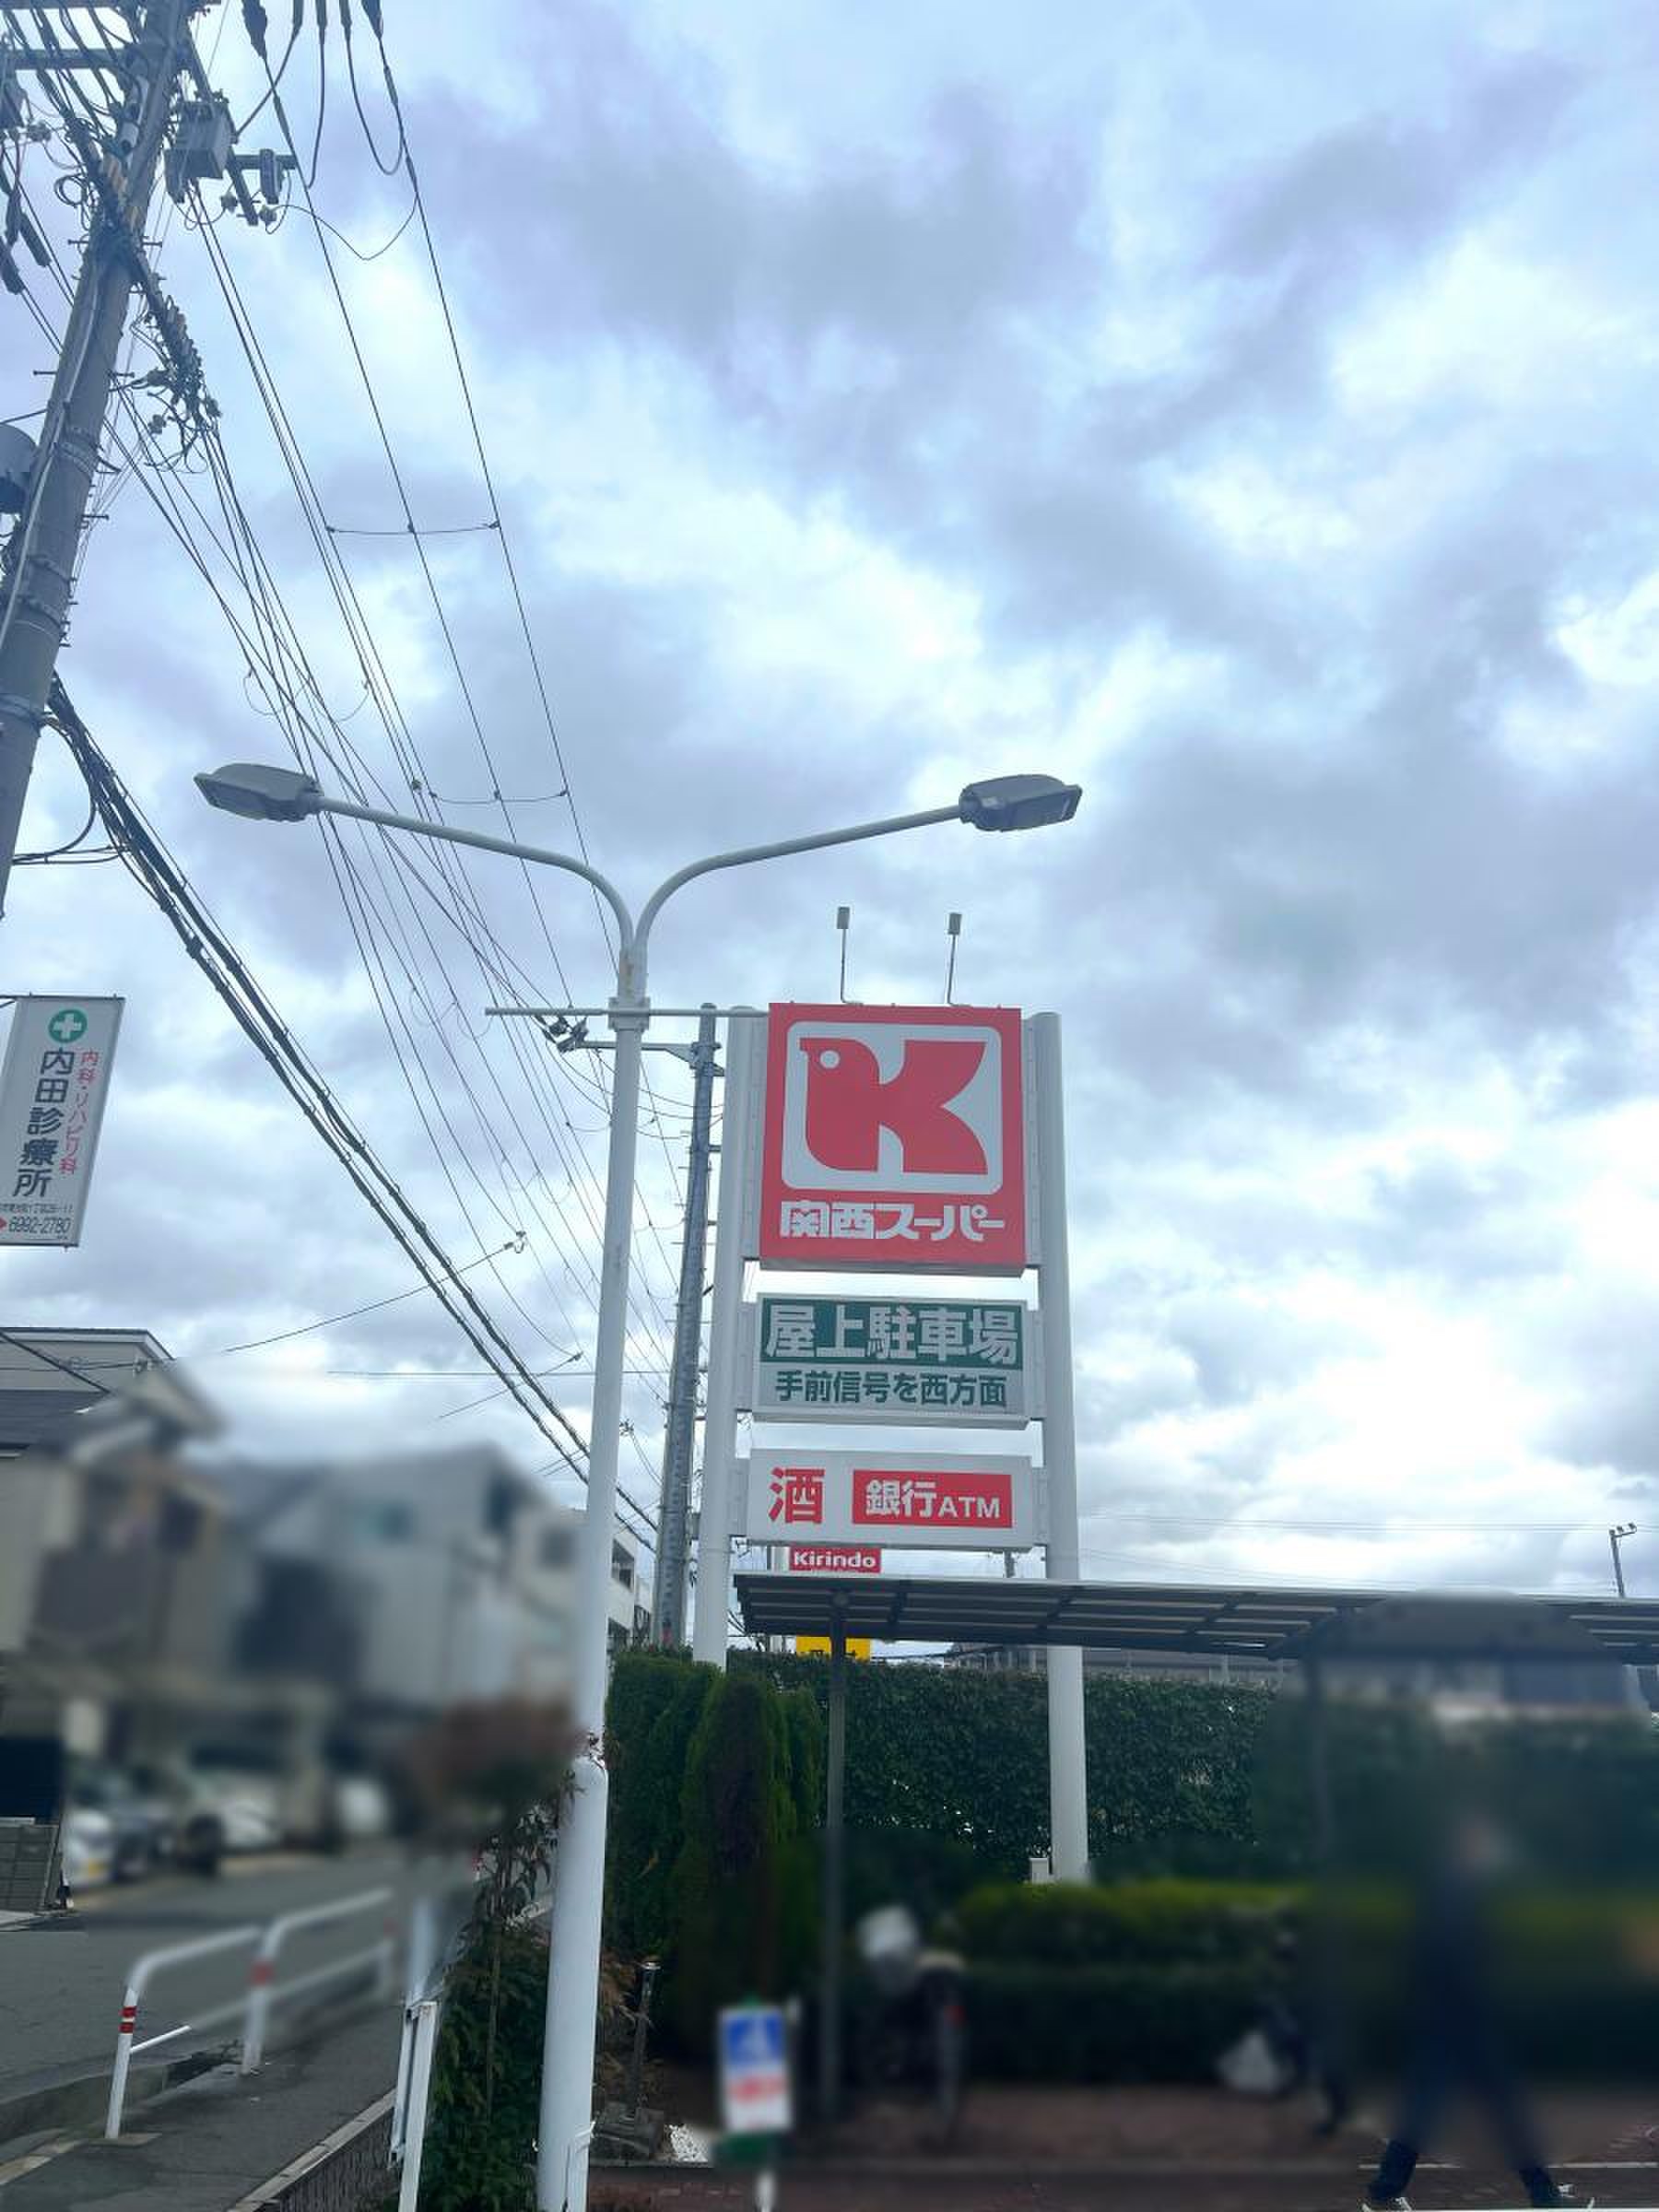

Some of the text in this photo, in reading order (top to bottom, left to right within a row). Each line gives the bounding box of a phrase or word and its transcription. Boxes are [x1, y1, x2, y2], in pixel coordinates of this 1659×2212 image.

[12, 1047, 75, 1197] 内田診療所
[780, 1200, 1005, 1241] 関西スーパー
[765, 1303, 1018, 1364] 屋上駐車場
[775, 1370, 1007, 1407] 手前信号を西方面
[768, 1466, 825, 1524] 酒
[794, 1550, 877, 1568] Kirindo
